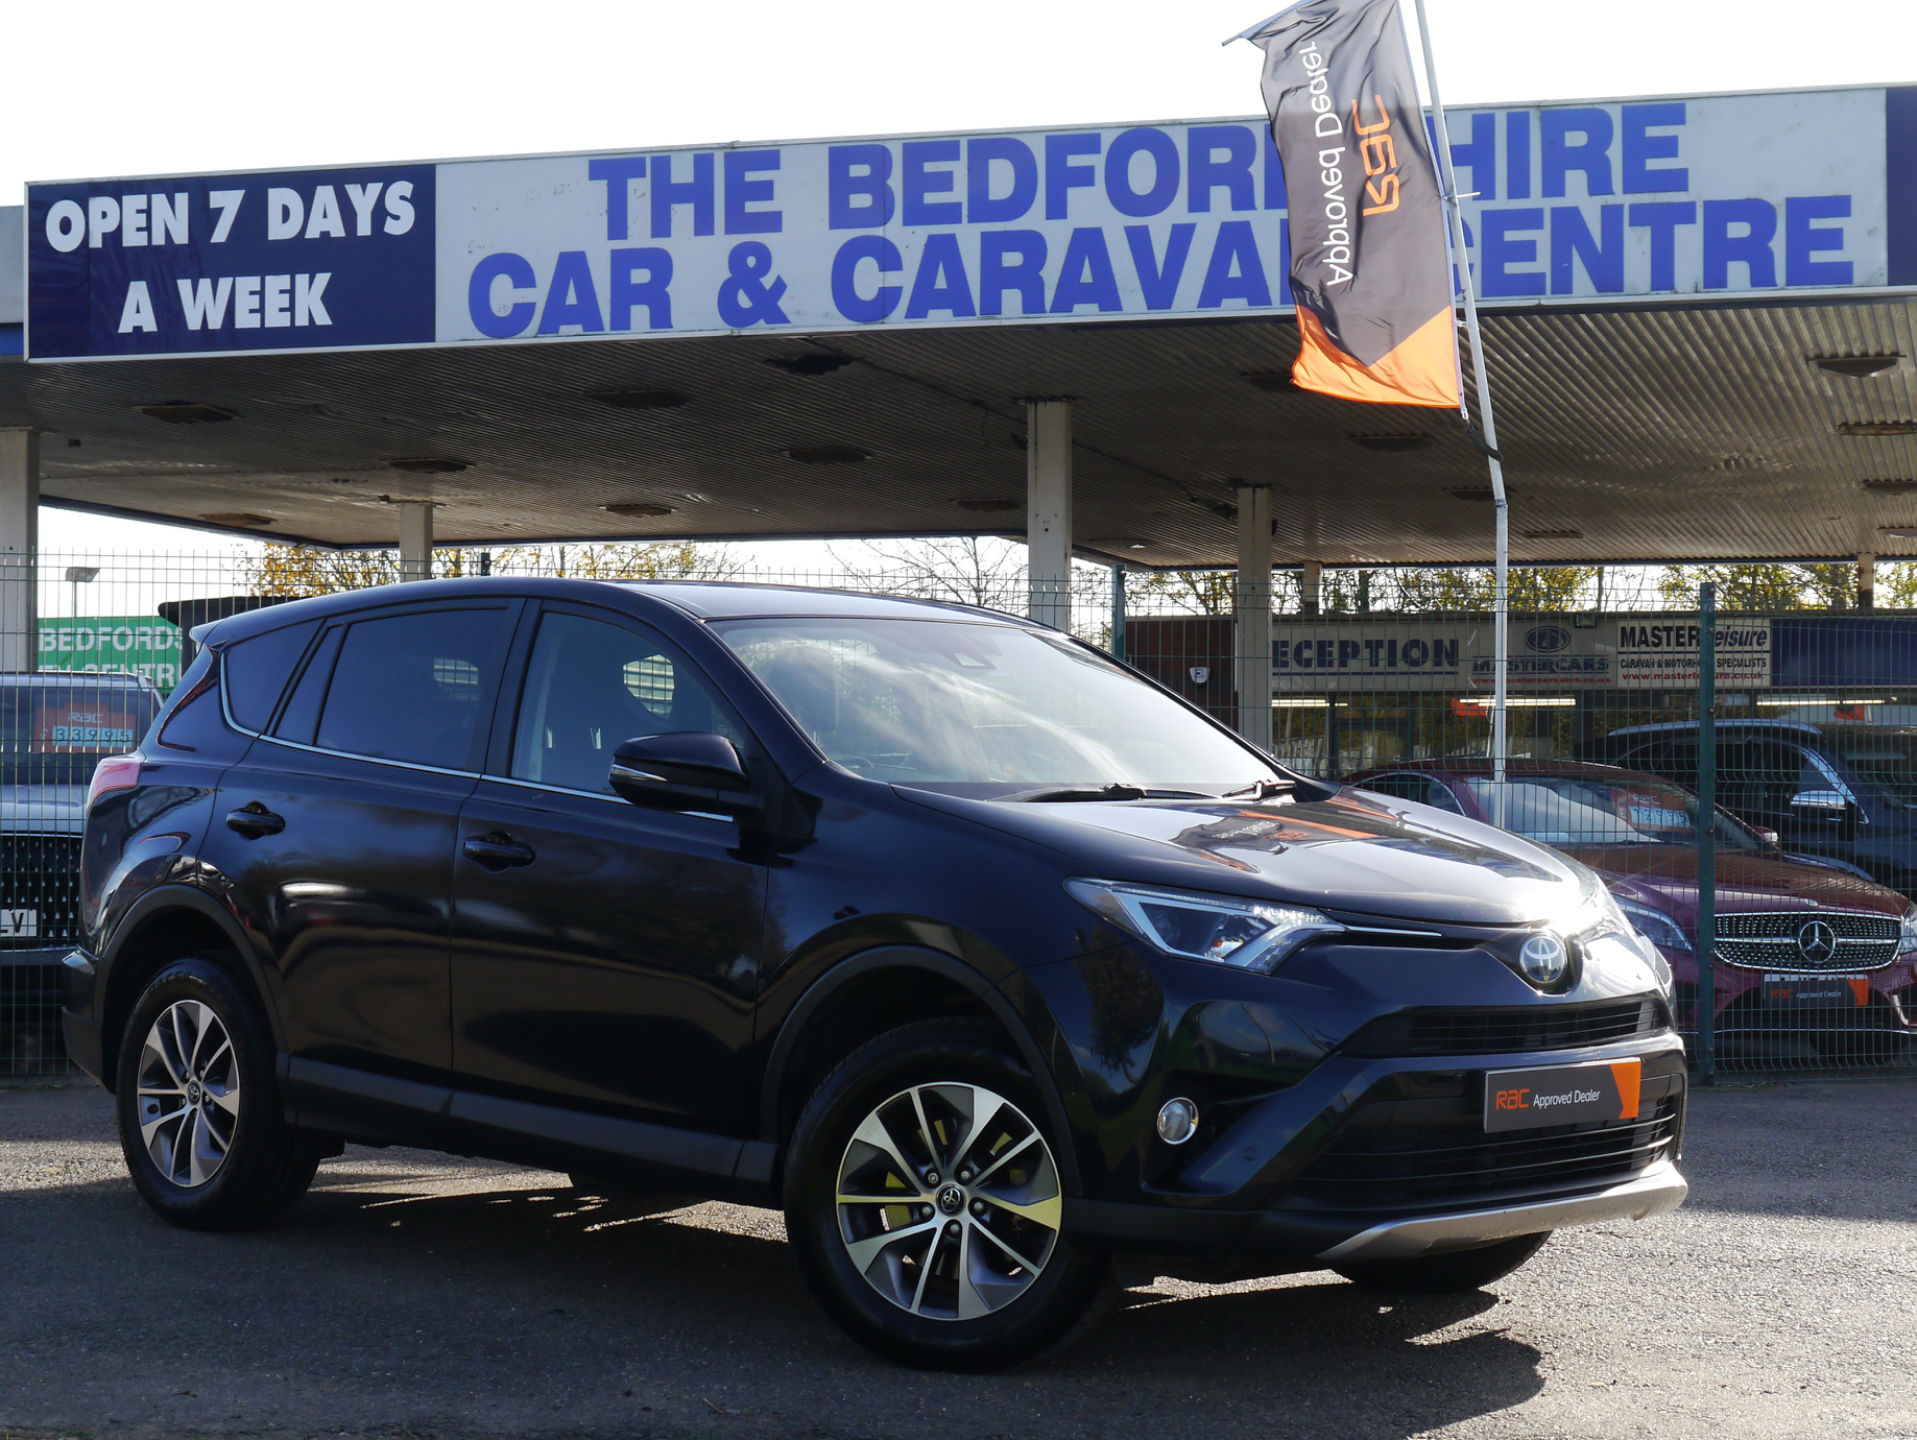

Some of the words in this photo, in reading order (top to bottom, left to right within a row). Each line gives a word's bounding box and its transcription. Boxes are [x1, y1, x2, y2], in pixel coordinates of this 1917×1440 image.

[588, 149, 783, 241] THE
[827, 102, 1690, 230] BEDFORHIRE
[45, 192, 190, 253] OPEN
[209, 189, 246, 244] 7
[267, 181, 416, 241] DAYS
[468, 247, 673, 339] CAR
[716, 240, 791, 330] &
[831, 218, 1291, 323] CARAVA
[117, 281, 158, 334] A
[177, 272, 333, 331] WEEK
[1714, 624, 1768, 647] eisure
[1272, 639, 1460, 669] ECEPTION
[1620, 658, 1655, 669] CARAVAN
[1716, 657, 1767, 668] SPECIALISTS
[56, 728, 130, 743] 33995
[1533, 1091, 1573, 1110] Approved
[1574, 1088, 1601, 1103] Dealer
